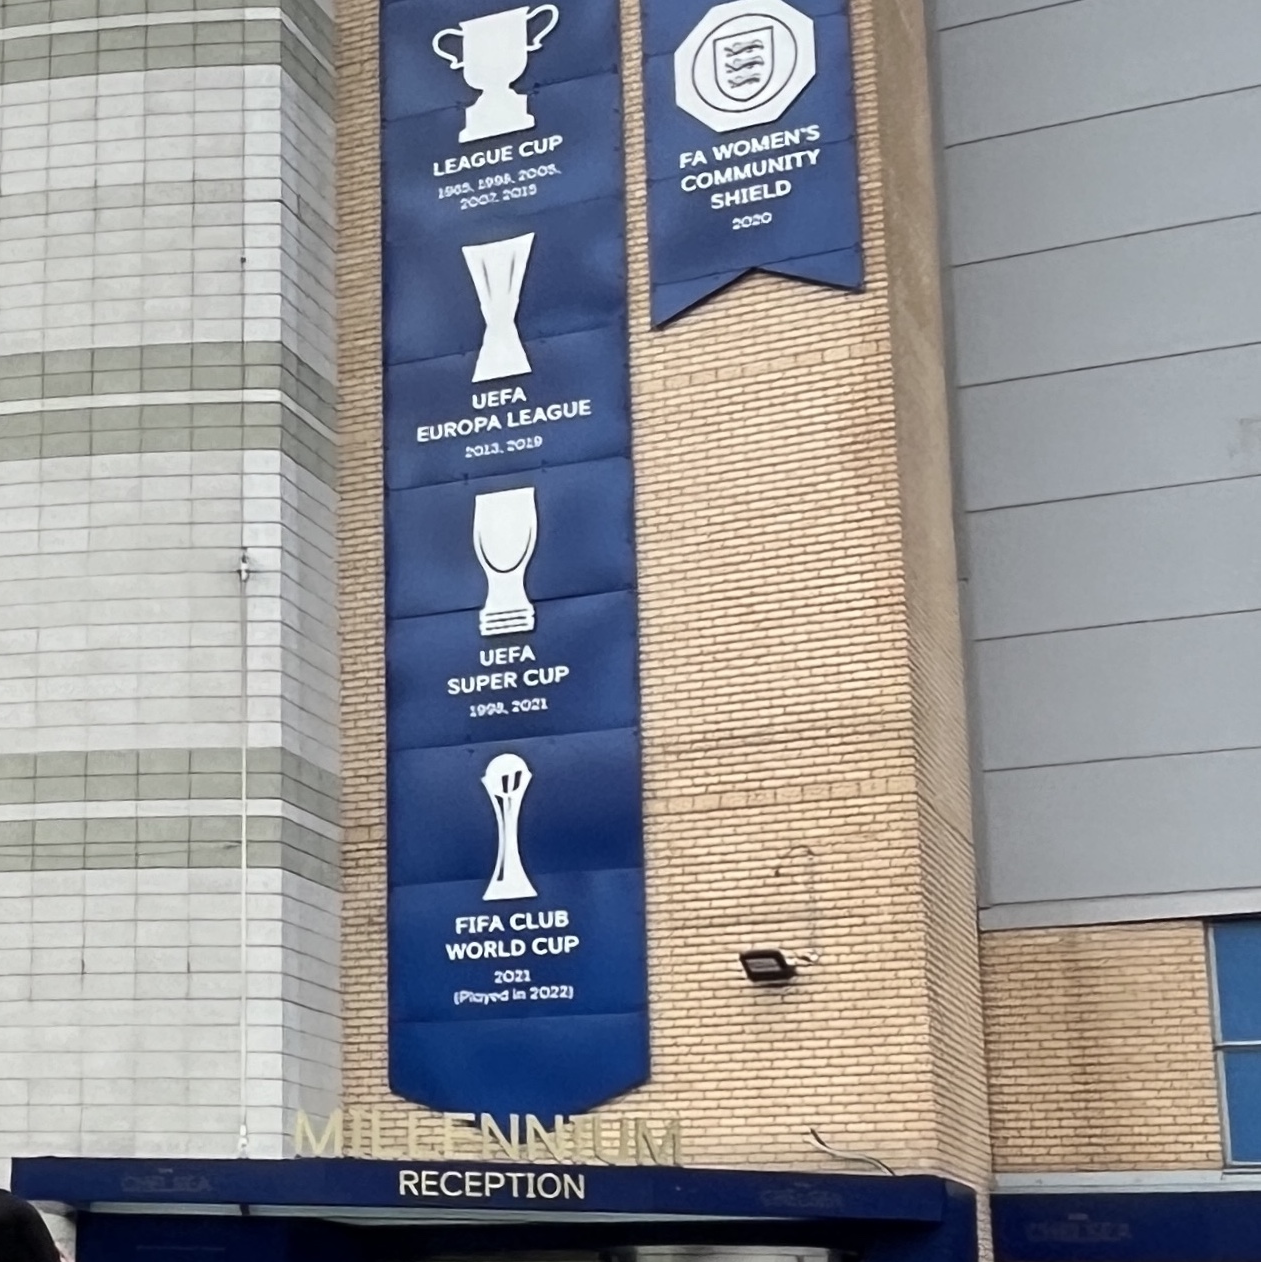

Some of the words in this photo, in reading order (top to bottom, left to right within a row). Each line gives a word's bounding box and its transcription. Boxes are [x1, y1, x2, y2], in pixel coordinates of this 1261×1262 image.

[433, 145, 514, 176] LEAGUE
[518, 135, 563, 157] CUP
[679, 150, 708, 169] FA
[712, 124, 821, 161] WOMEN'S
[681, 149, 821, 192] COMMUNITY
[710, 180, 792, 209] SHIELD
[732, 212, 773, 230] 2020
[472, 386, 527, 410] UEFA
[416, 414, 502, 442] EUROPA
[507, 399, 592, 428] LEAGUE
[479, 645, 536, 666] UEFA
[447, 672, 518, 695] SUPER
[523, 665, 570, 686] CUP
[511, 698, 548, 713] 2021
[455, 915, 505, 934] FIFA
[509, 910, 569, 931] CLUB
[445, 939, 526, 960] WORLD
[531, 935, 580, 955] CUP
[494, 969, 531, 984] 2021
[453, 989, 509, 1005] (Played
[512, 988, 526, 1000] in
[529, 985, 574, 1000] 2022)
[295, 1108, 681, 1166] MILLENNIUM
[398, 1170, 585, 1200] RECEPTION
